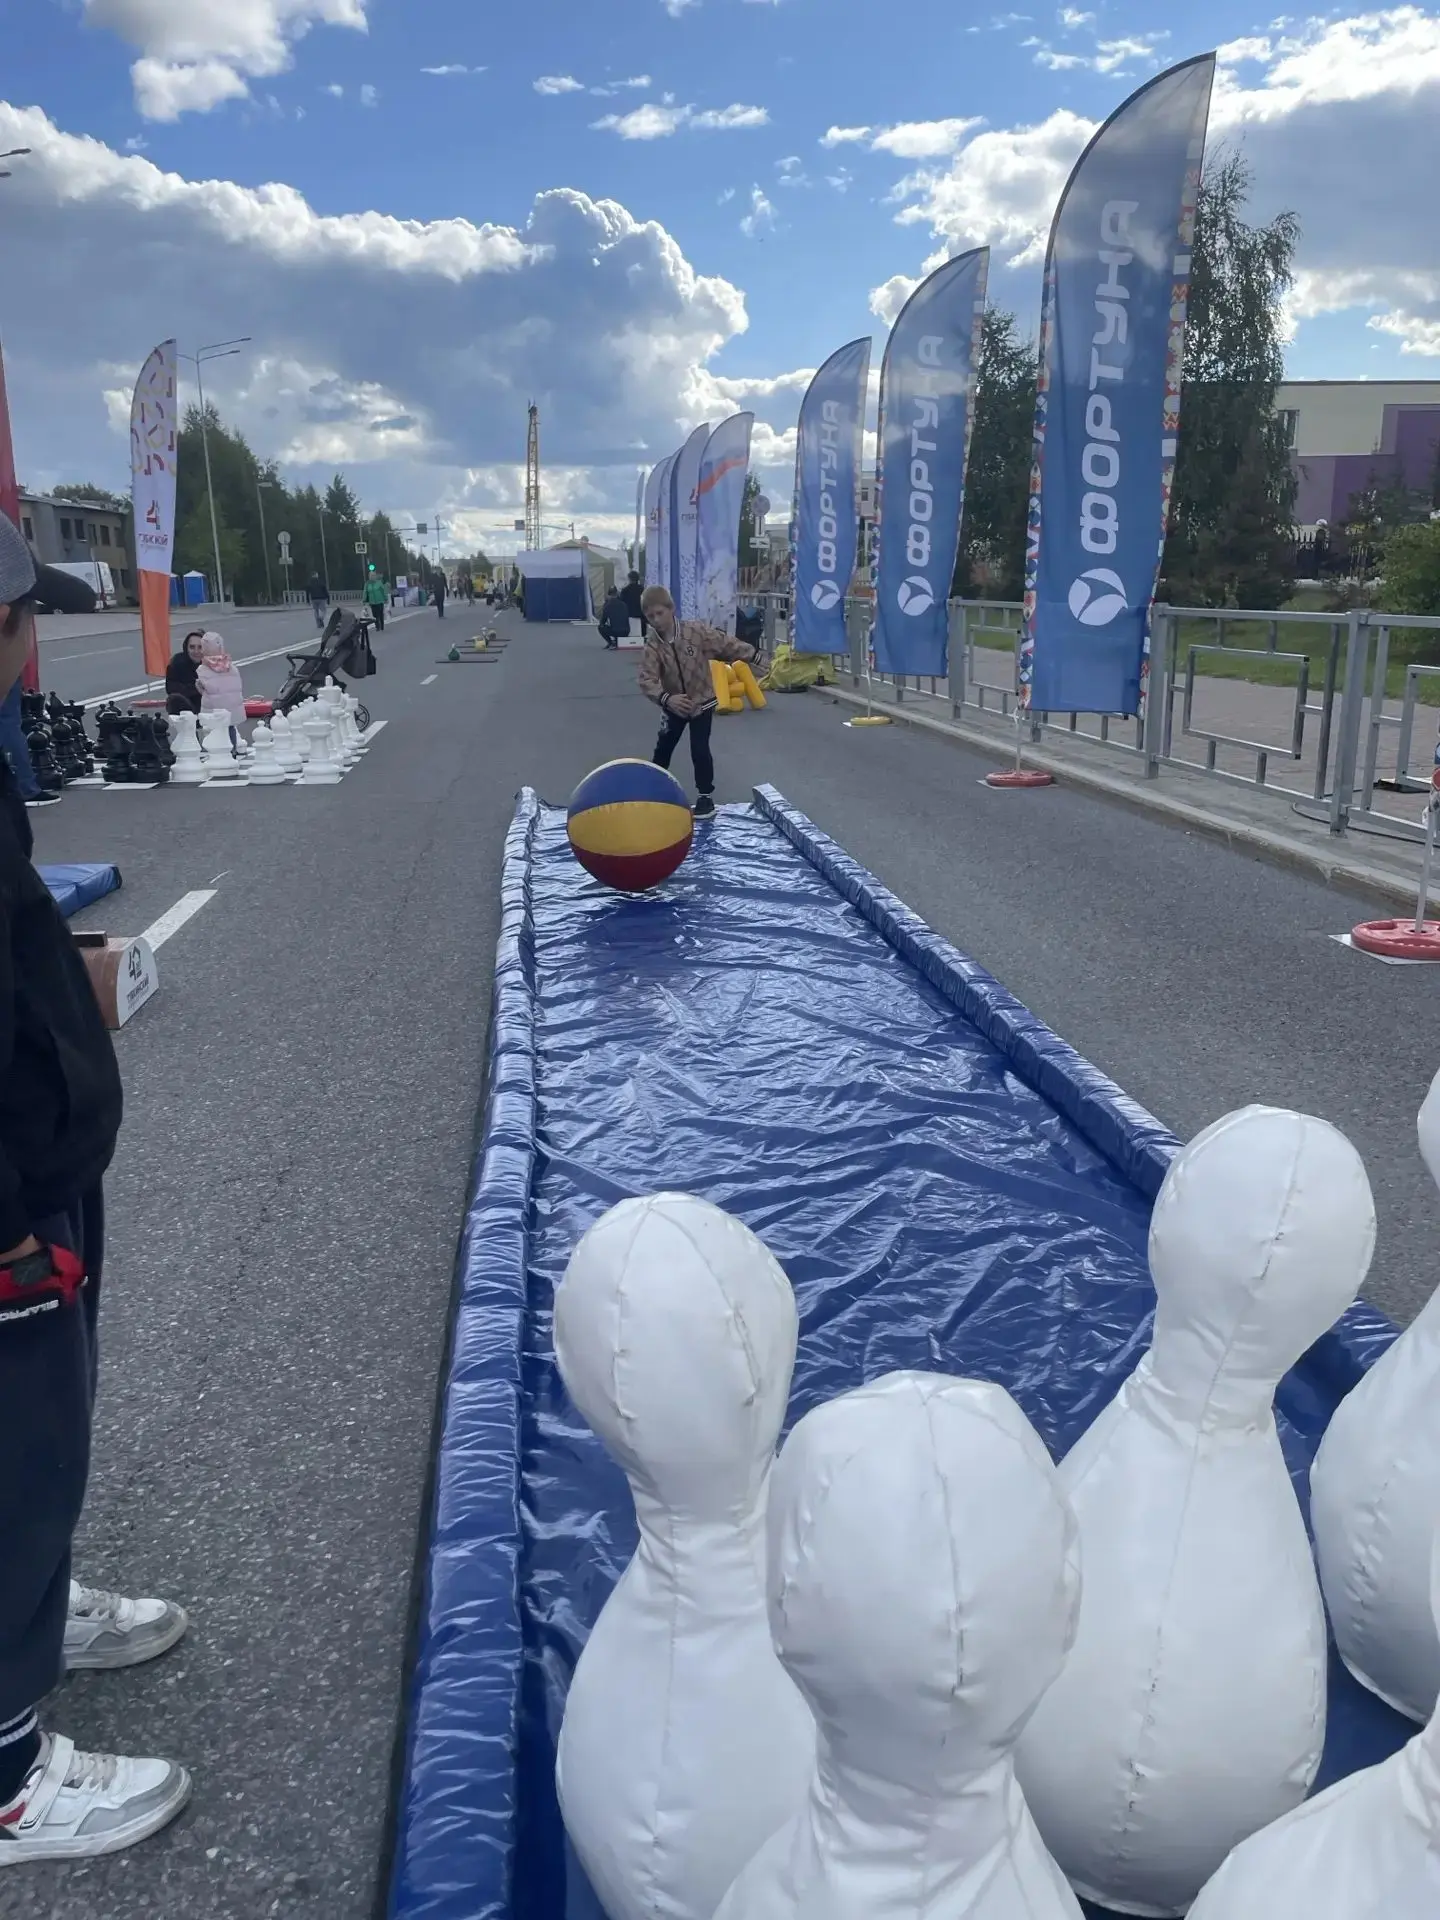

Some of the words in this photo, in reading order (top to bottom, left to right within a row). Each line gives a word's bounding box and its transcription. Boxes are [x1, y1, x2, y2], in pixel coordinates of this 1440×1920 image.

[816, 399, 841, 573] ФОРТУНА
[905, 335, 944, 568] ФОРТУНА
[1079, 200, 1140, 555] ФОРТУНА
